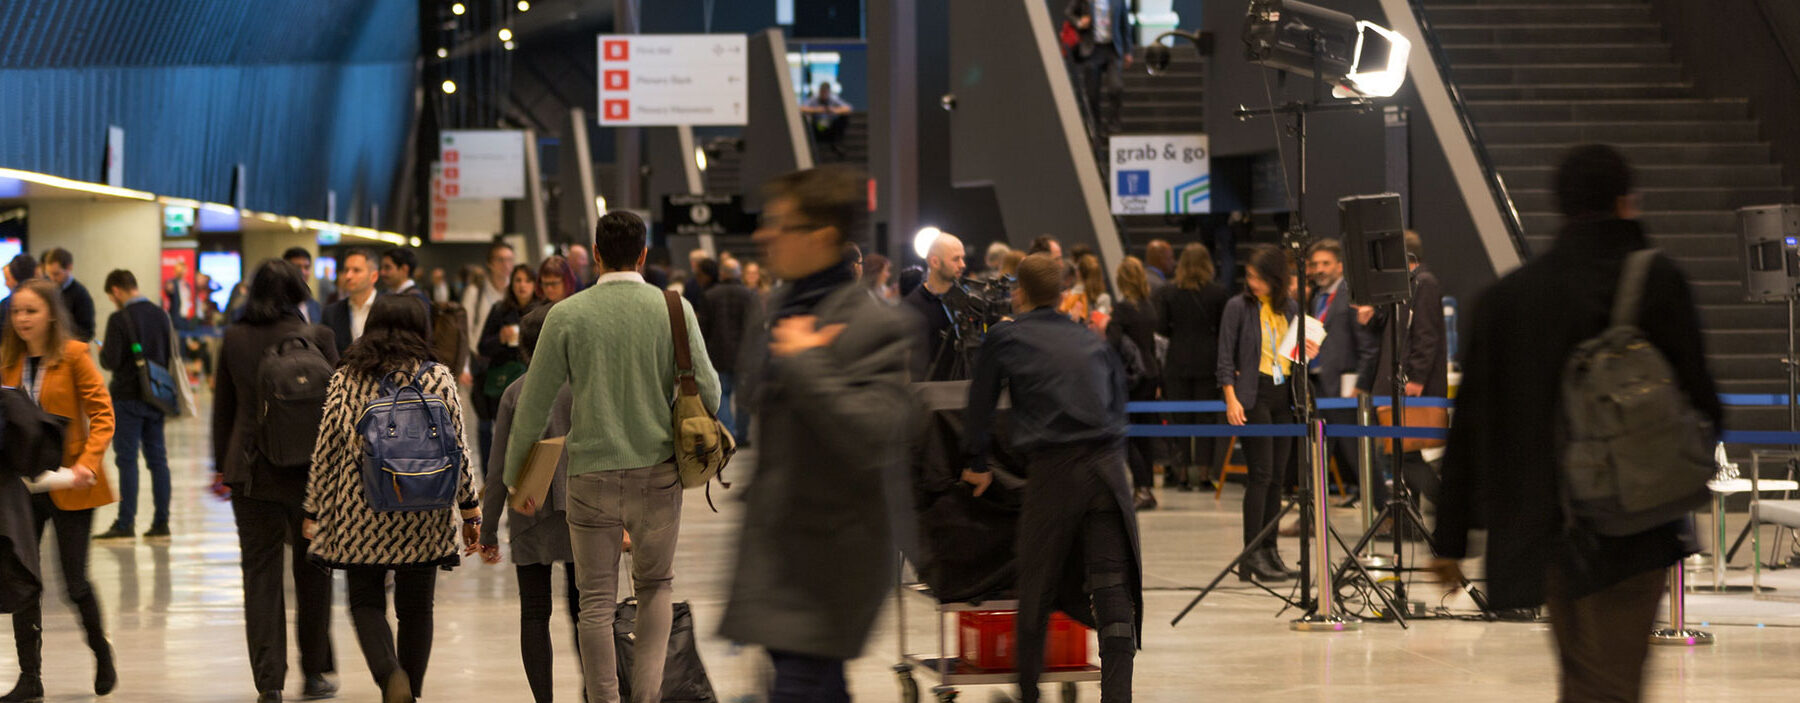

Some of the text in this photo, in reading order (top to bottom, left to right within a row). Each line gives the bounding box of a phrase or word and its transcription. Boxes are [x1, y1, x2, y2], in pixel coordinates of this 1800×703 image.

[1116, 143, 1205, 164] grab & go
